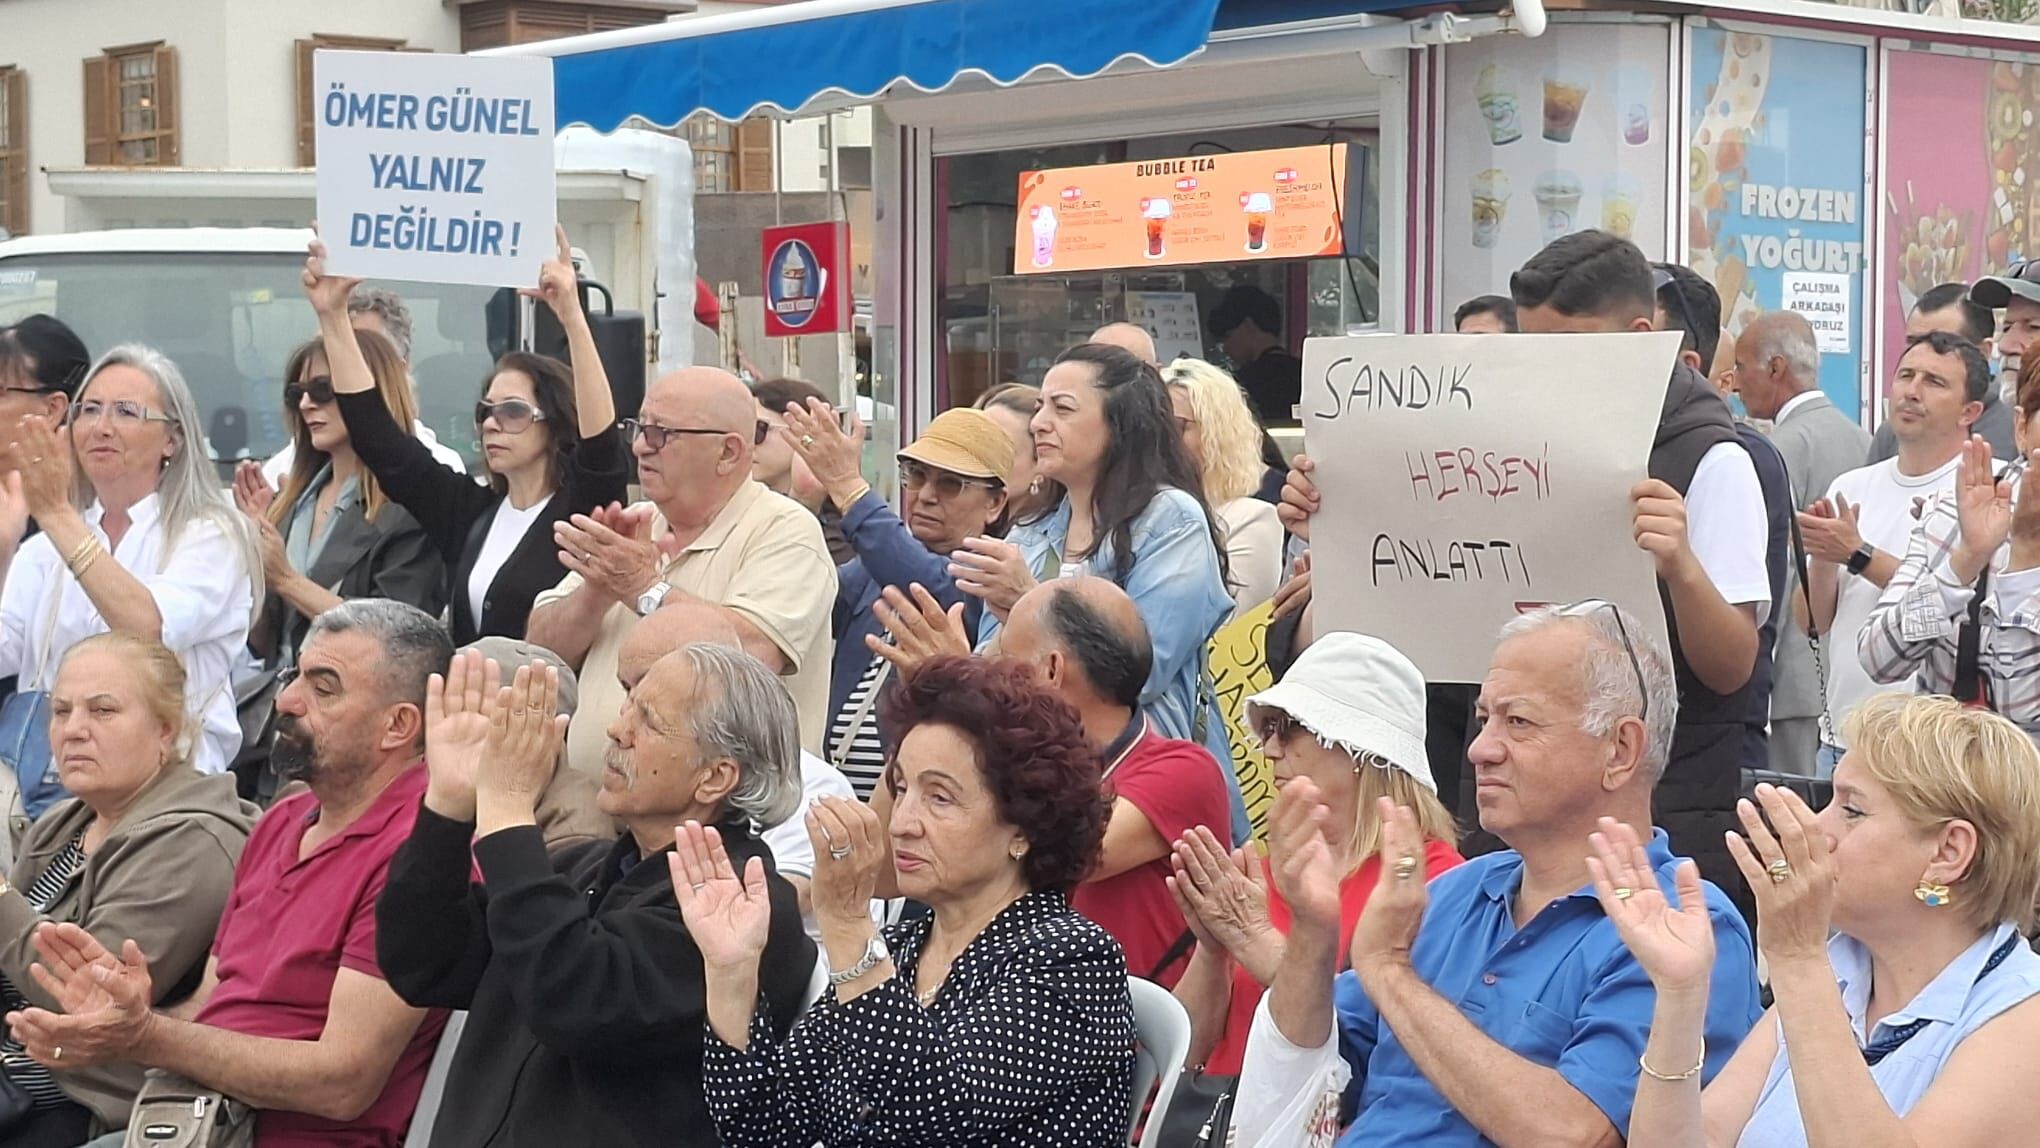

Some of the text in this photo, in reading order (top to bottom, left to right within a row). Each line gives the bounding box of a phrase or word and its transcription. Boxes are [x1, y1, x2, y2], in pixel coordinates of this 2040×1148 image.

[324, 82, 540, 136] ÖMER GÜNEL
[369, 153, 486, 194] YALNIZ
[1136, 158, 1216, 177] BUBBLE TEA
[1741, 183, 1857, 224] FROZEN
[349, 205, 504, 257] DEĞİLDİR
[1740, 228, 1864, 275] YOĞURT
[1790, 300, 1845, 316] ARKADAŞI
[1792, 282, 1841, 296] ÇALIŞMA
[1315, 357, 1473, 419] SANDIK
[1371, 533, 1531, 588] ANLATTI
